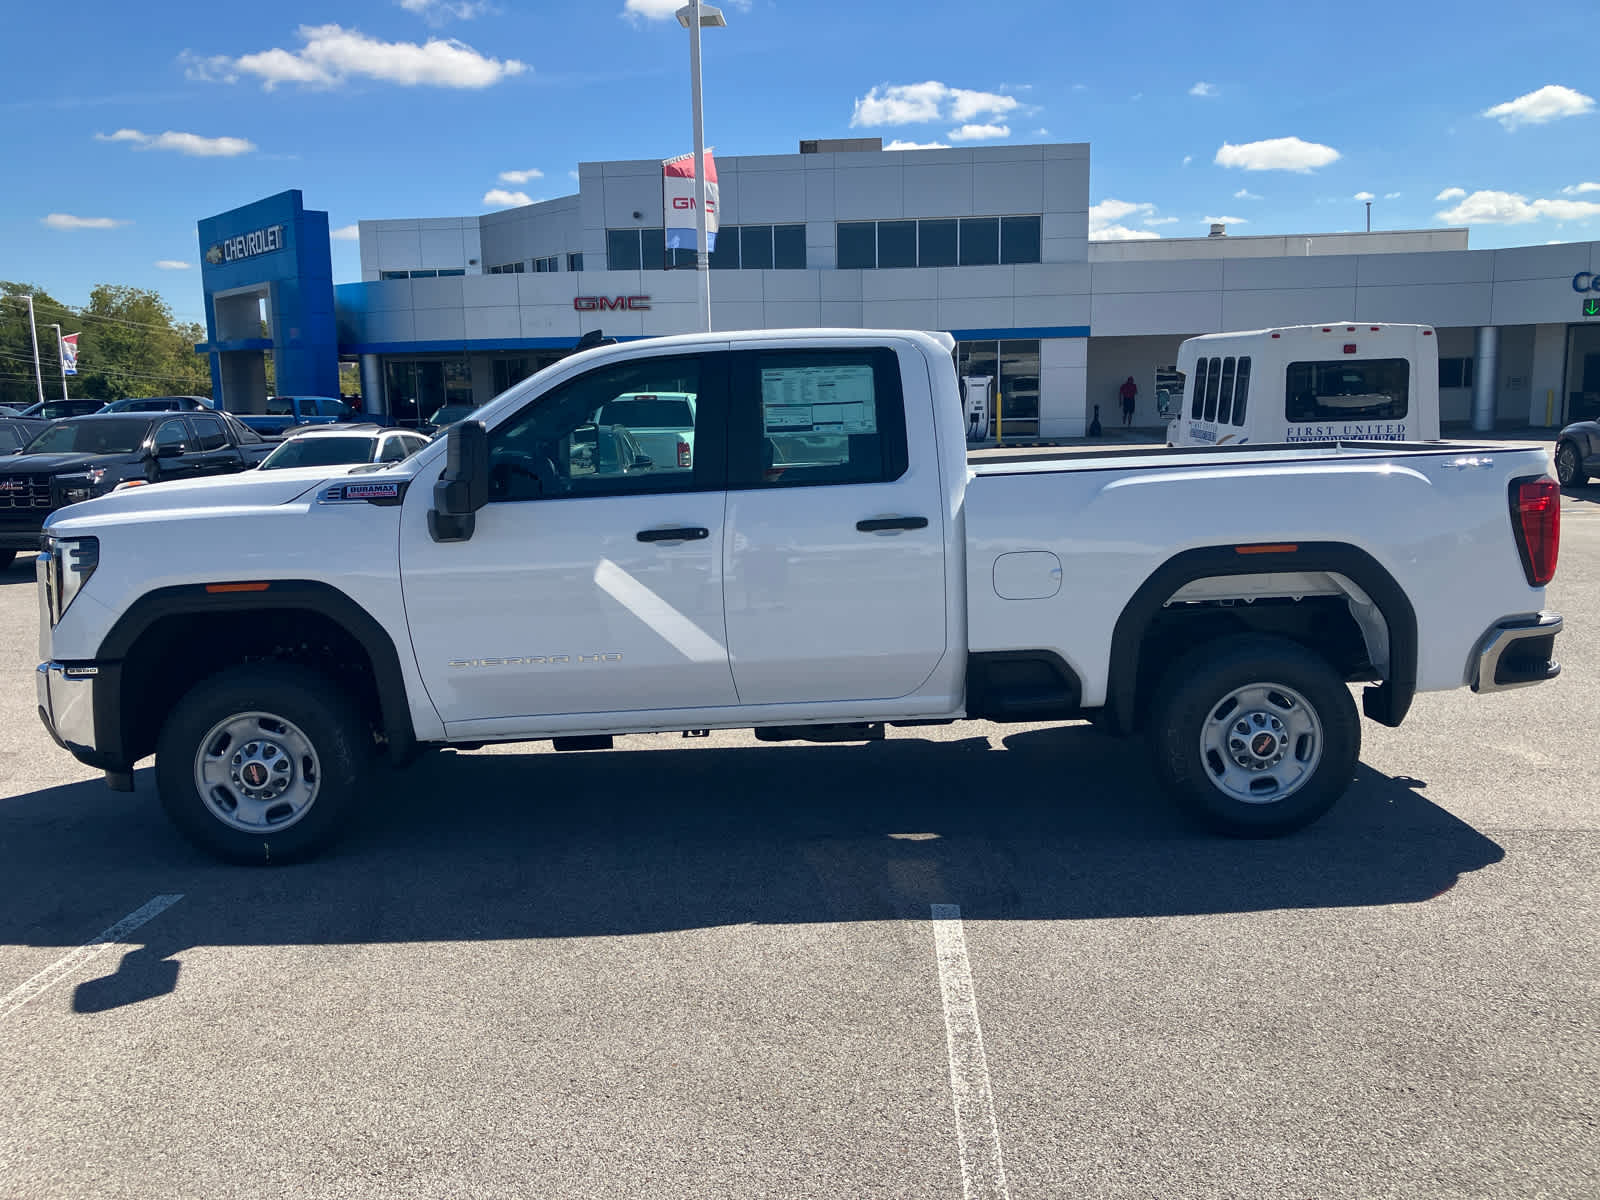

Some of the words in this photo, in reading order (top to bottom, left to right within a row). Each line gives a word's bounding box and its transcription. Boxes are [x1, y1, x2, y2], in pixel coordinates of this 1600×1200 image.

[224, 225, 282, 261] CHEVROLET
[574, 296, 651, 311] GMC
[1287, 426, 1334, 436] FIRST
[1344, 423, 1405, 434] UNITED
[350, 485, 395, 493] DURAMAX
[448, 655, 570, 668] SIERRA
[577, 652, 623, 663] HD
